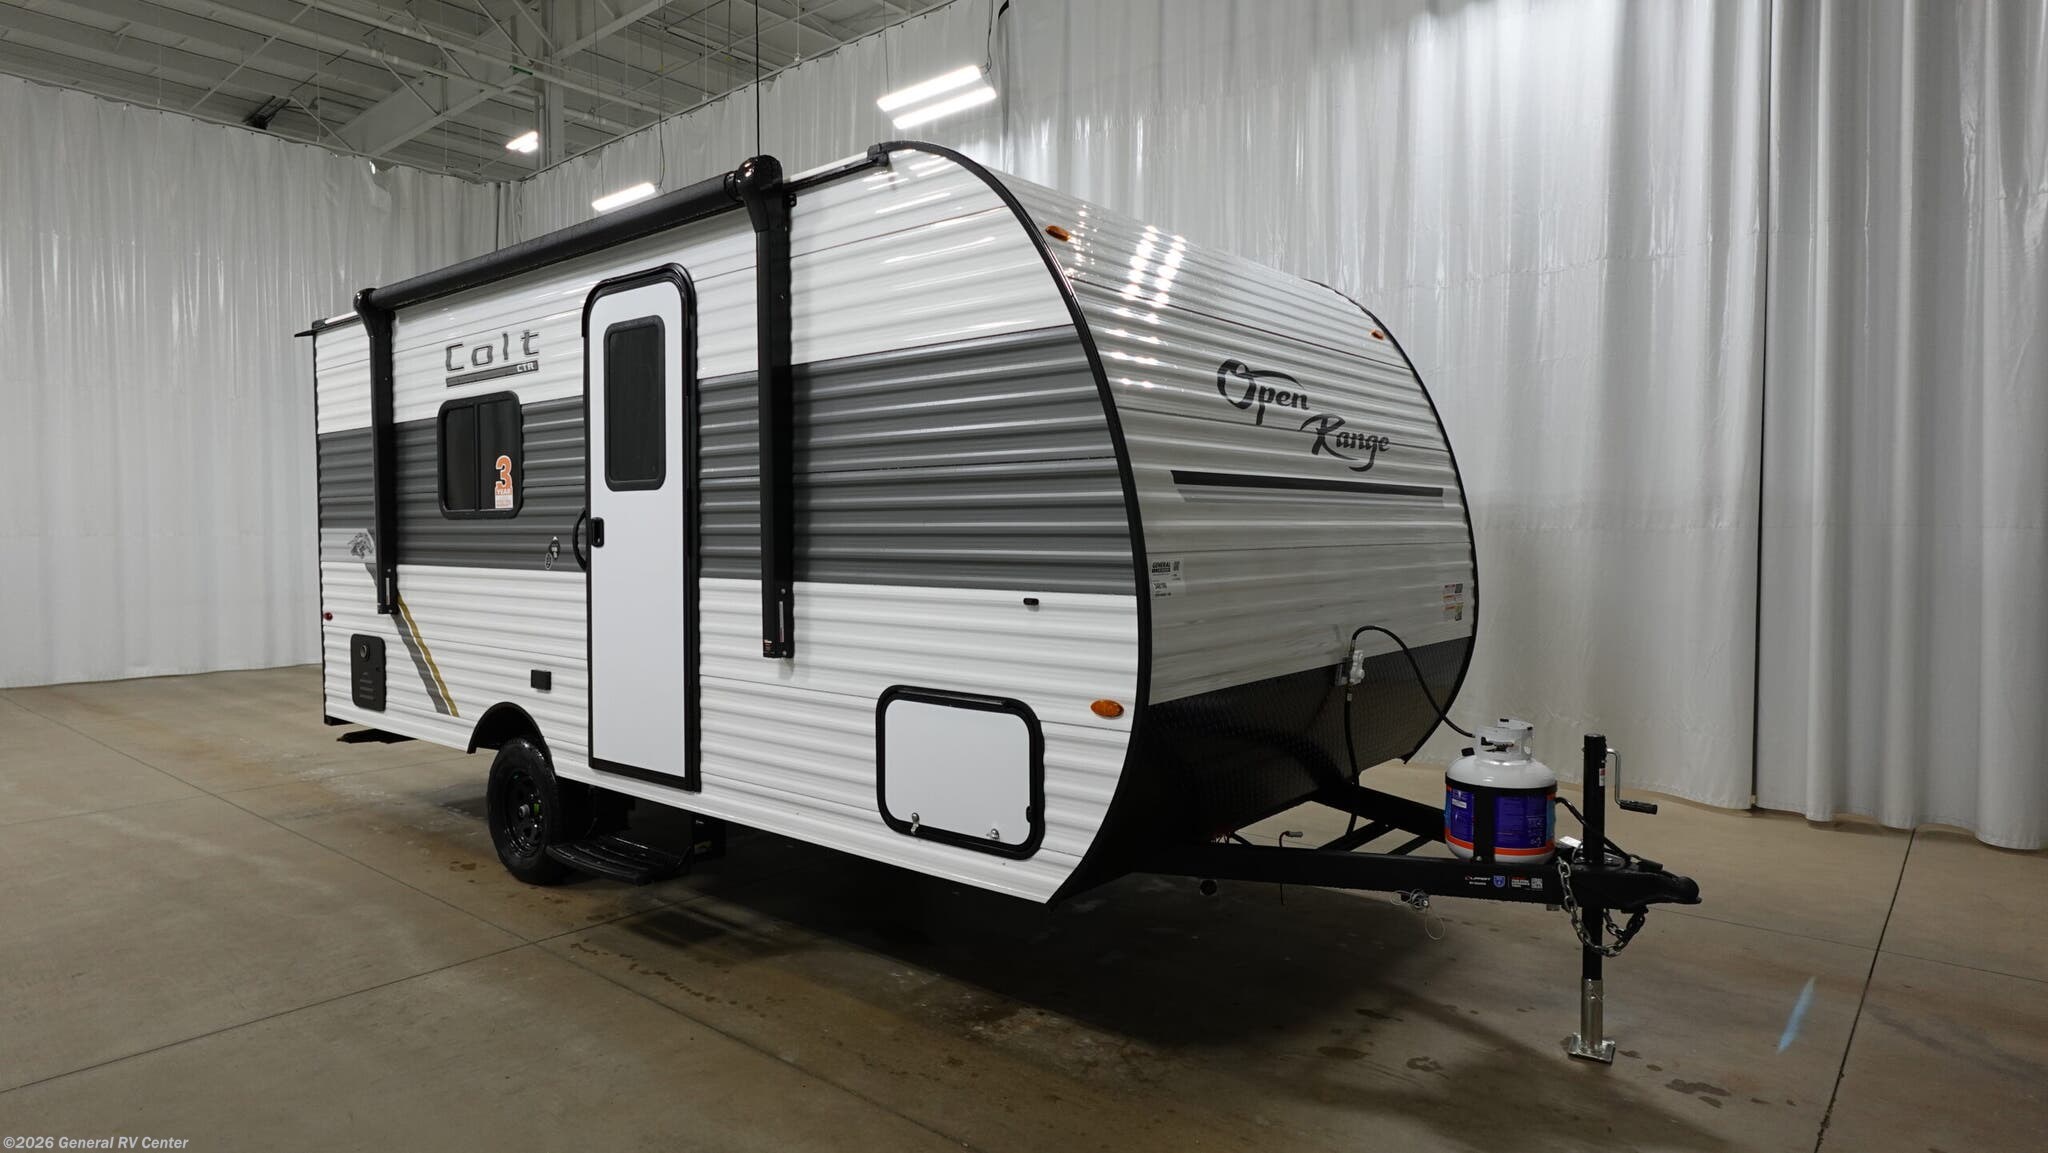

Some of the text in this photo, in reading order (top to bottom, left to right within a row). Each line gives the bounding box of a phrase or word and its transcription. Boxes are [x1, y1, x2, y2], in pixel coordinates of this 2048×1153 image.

[446, 331, 539, 371] Colt
[516, 362, 535, 372] CTR
[1217, 359, 1310, 425] Open
[1300, 413, 1390, 472] Range
[496, 455, 512, 489] 3
